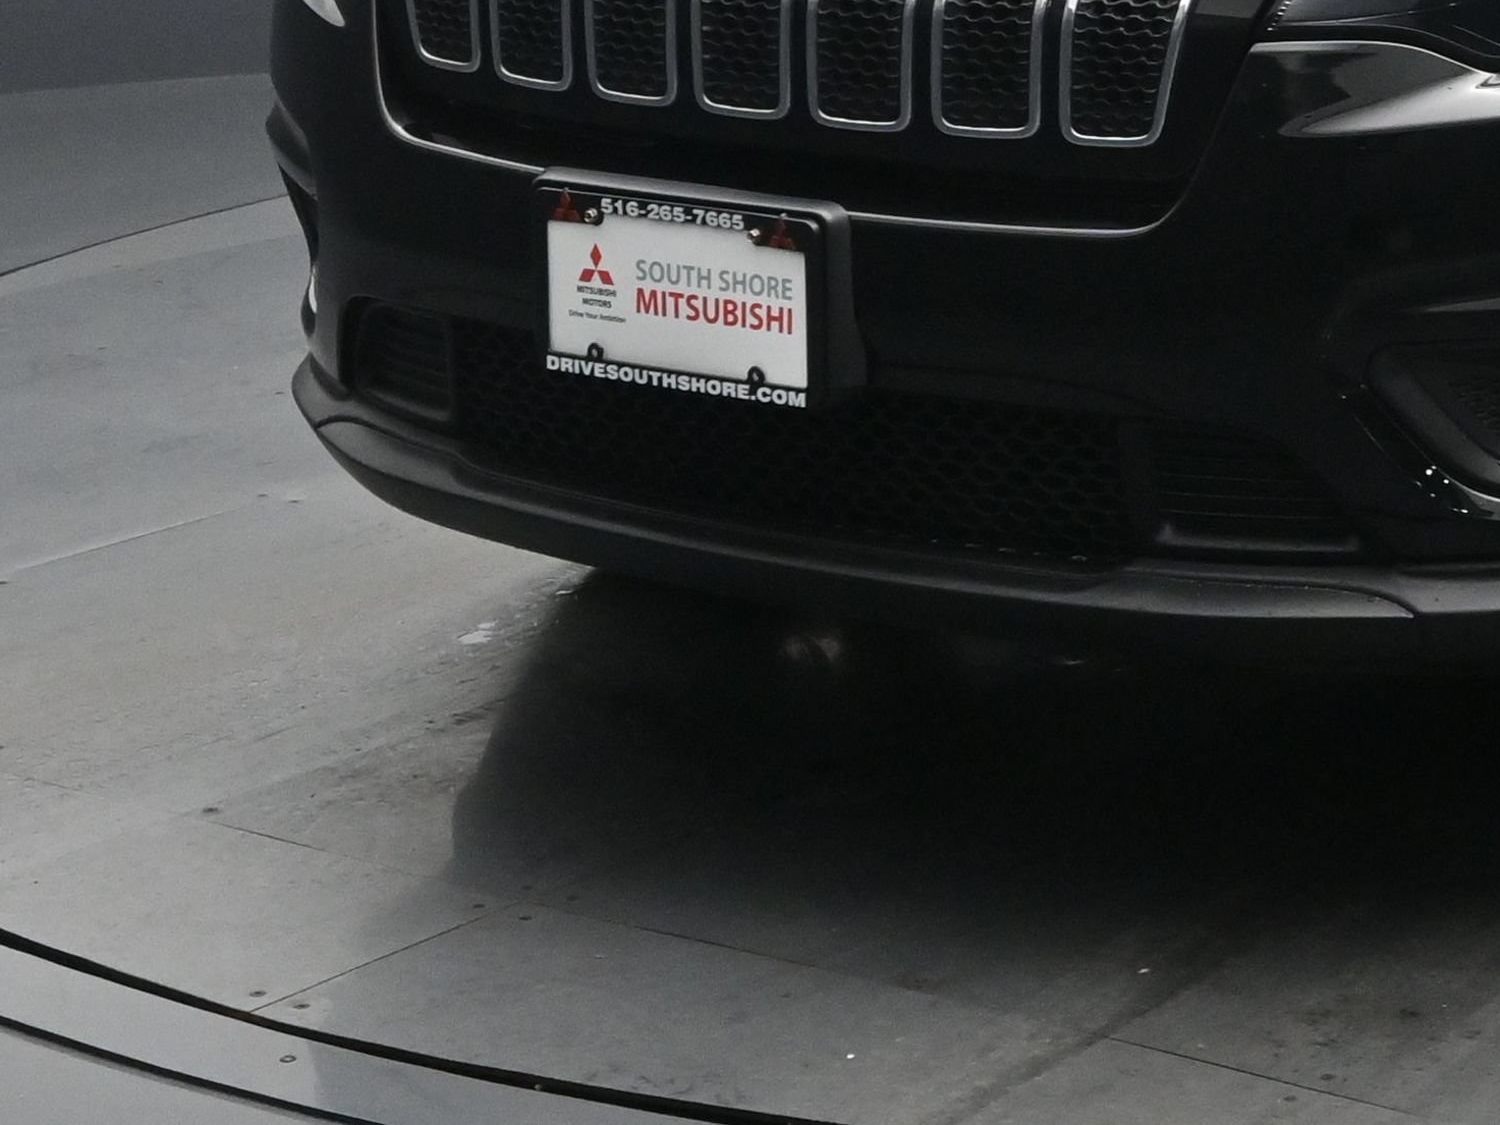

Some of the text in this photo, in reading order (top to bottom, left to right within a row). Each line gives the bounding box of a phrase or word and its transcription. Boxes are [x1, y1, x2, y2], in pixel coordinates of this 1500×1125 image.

[601, 198, 744, 230] 516-265-7665
[636, 259, 792, 300] SOUTH SHORE
[636, 287, 792, 335] MITSUBISHI
[546, 355, 806, 408] DRIVESOUTHSHORE.COM
